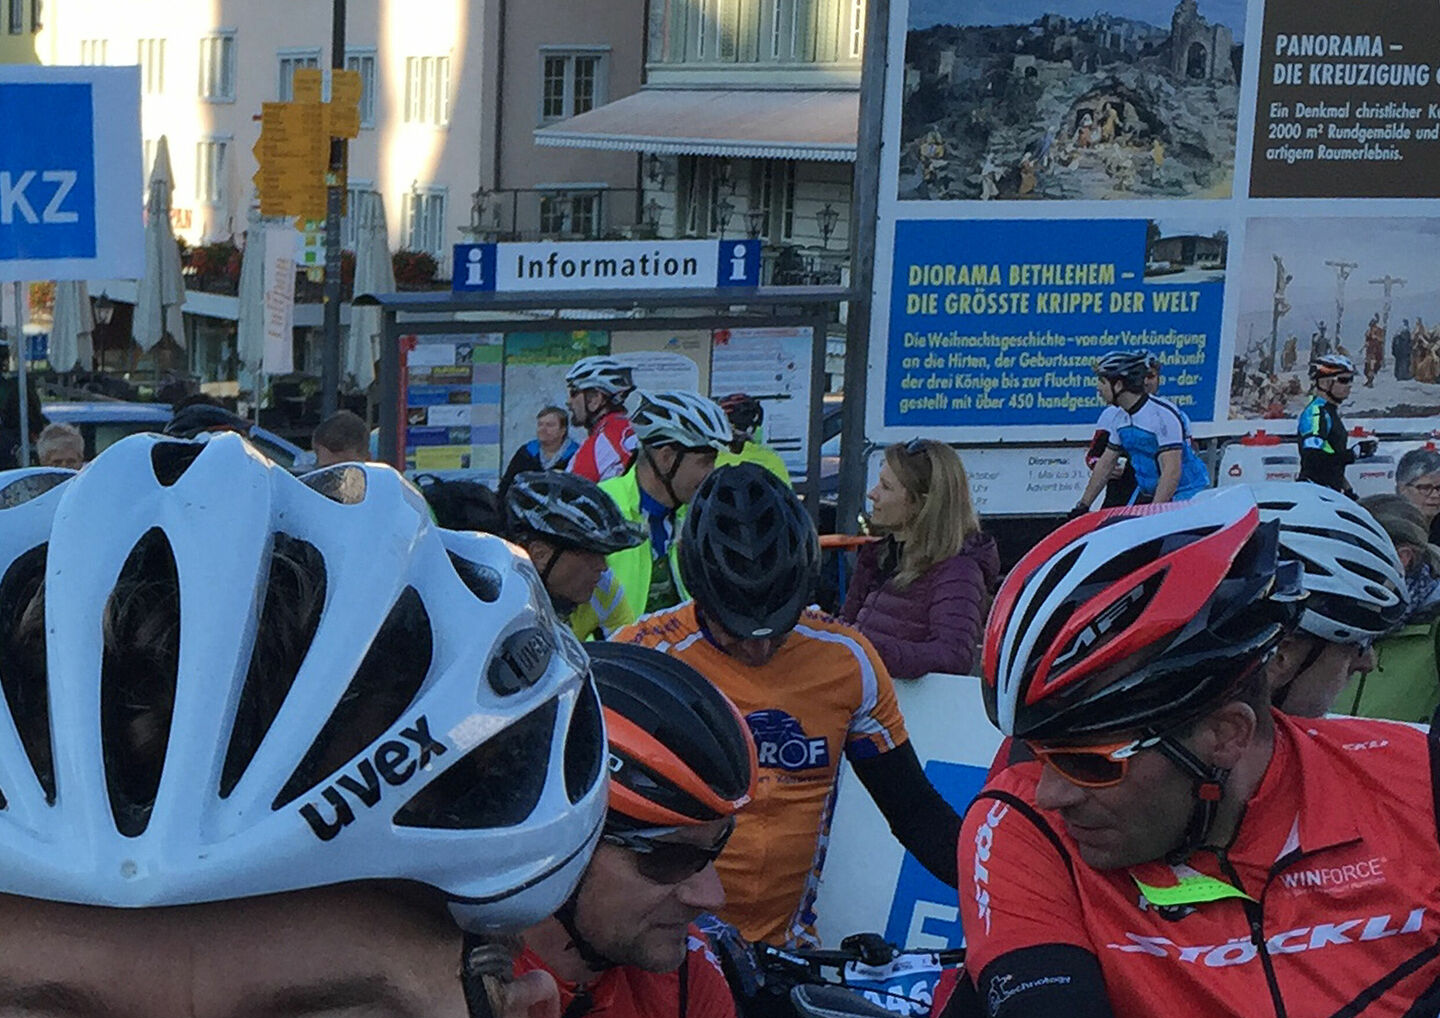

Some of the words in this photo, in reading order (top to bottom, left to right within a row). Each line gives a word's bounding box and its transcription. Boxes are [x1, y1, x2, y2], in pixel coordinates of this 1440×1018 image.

[1275, 34, 1383, 57] PANORAMA
[1273, 63, 1303, 85] DIE
[1309, 63, 1430, 86] KREUZIGUNG
[1269, 102, 1289, 119] Ein
[1295, 101, 1350, 119] Denkmal
[1356, 101, 1422, 119] christlicher
[1268, 123, 1301, 139] 2000
[1328, 122, 1411, 143] Rundgemälde
[1266, 144, 1313, 164] artigem
[1317, 143, 1403, 160] Raumerlebnis.
[517, 251, 698, 279] Information
[908, 264, 1001, 286] DIORAMA
[1009, 263, 1115, 286] BETHLEHEM
[906, 293, 938, 314] DIE
[945, 287, 1030, 315] GRÖSSTE
[1036, 292, 1103, 314] KRIPPE
[1110, 291, 1145, 313] DER
[1152, 291, 1200, 313] WELT
[904, 332, 927, 348] Die
[902, 357, 920, 368] an
[924, 353, 945, 368] die
[994, 353, 1016, 368] der
[901, 373, 923, 389] der
[927, 373, 953, 389] drei
[955, 373, 999, 393] Könige
[1001, 372, 1019, 388] bis
[1022, 377, 1041, 389] zur
[1045, 371, 1081, 387] Flucht
[1083, 375, 1098, 387] na
[951, 393, 972, 410] mit
[975, 392, 1005, 410] über
[1008, 393, 1034, 409] 450
[1036, 391, 1108, 412] handgesch
[759, 738, 826, 768] ROF
[298, 714, 448, 842] uvex
[1281, 859, 1385, 889] WINFORCE
